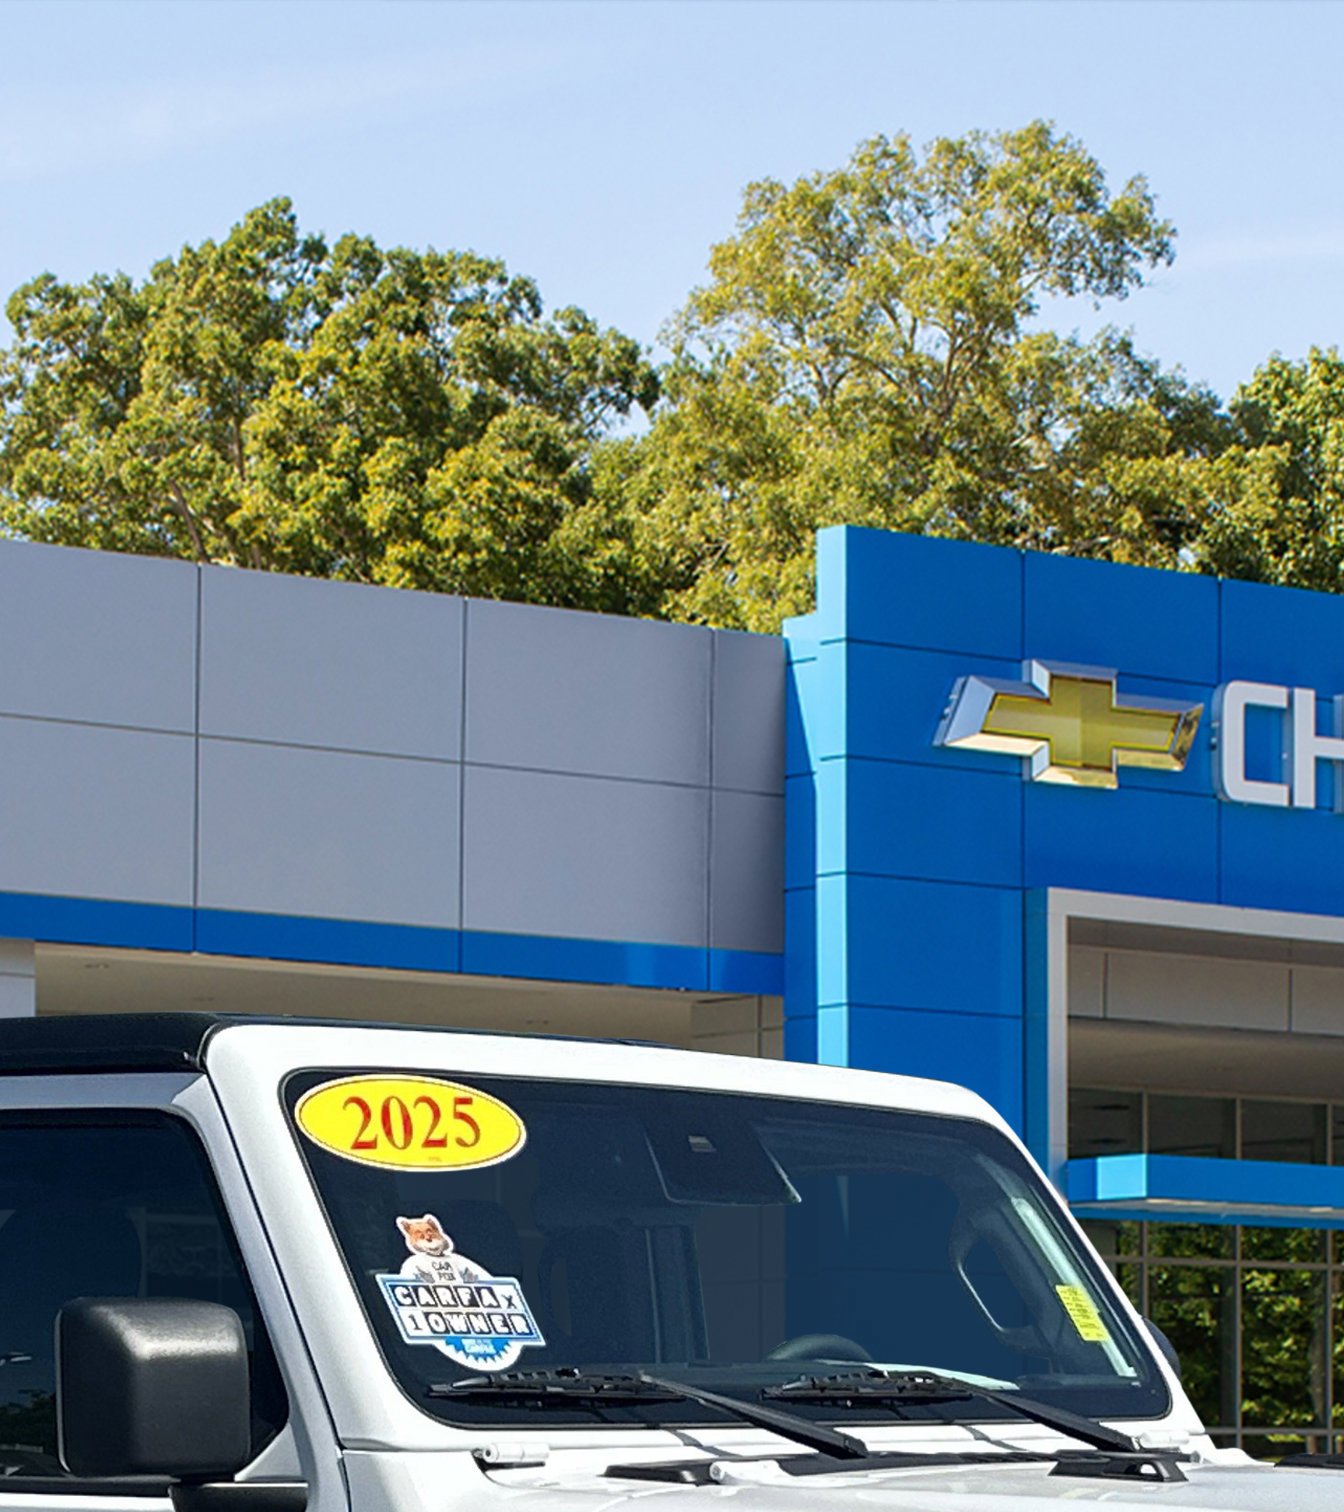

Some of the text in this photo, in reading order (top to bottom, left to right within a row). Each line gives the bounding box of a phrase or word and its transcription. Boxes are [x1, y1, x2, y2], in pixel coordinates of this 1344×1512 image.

[342, 1096, 481, 1150] 2025
[393, 1286, 517, 1309] CARFAX
[425, 1312, 534, 1336] OWNER
